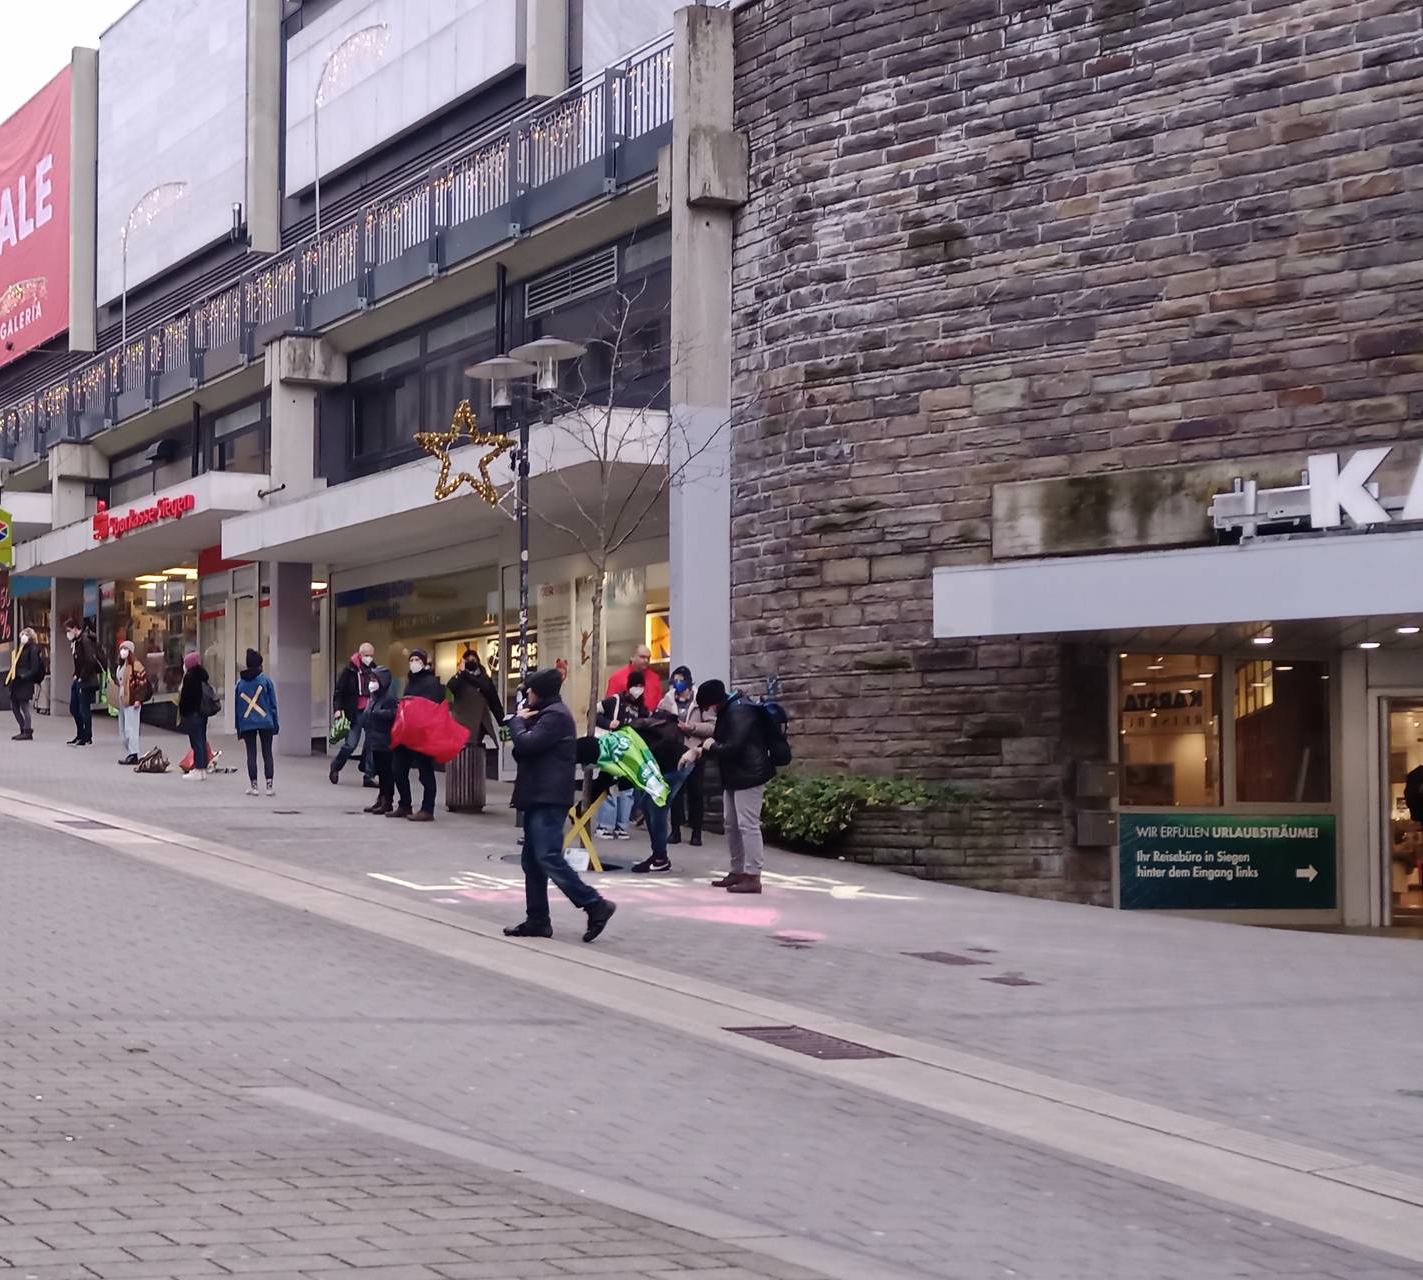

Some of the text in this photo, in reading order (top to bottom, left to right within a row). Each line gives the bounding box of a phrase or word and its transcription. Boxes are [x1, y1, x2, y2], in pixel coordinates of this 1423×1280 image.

[0, 301, 42, 340] GALERIA
[1308, 446, 1423, 528] K
[1136, 824, 1319, 839] WIR ERFÜLLEN URLAUBSTRÄUME!
[1137, 851, 1250, 865] Ihr Reisebüro in Siegen
[1137, 866, 1259, 881] hinter dem Eingang links
